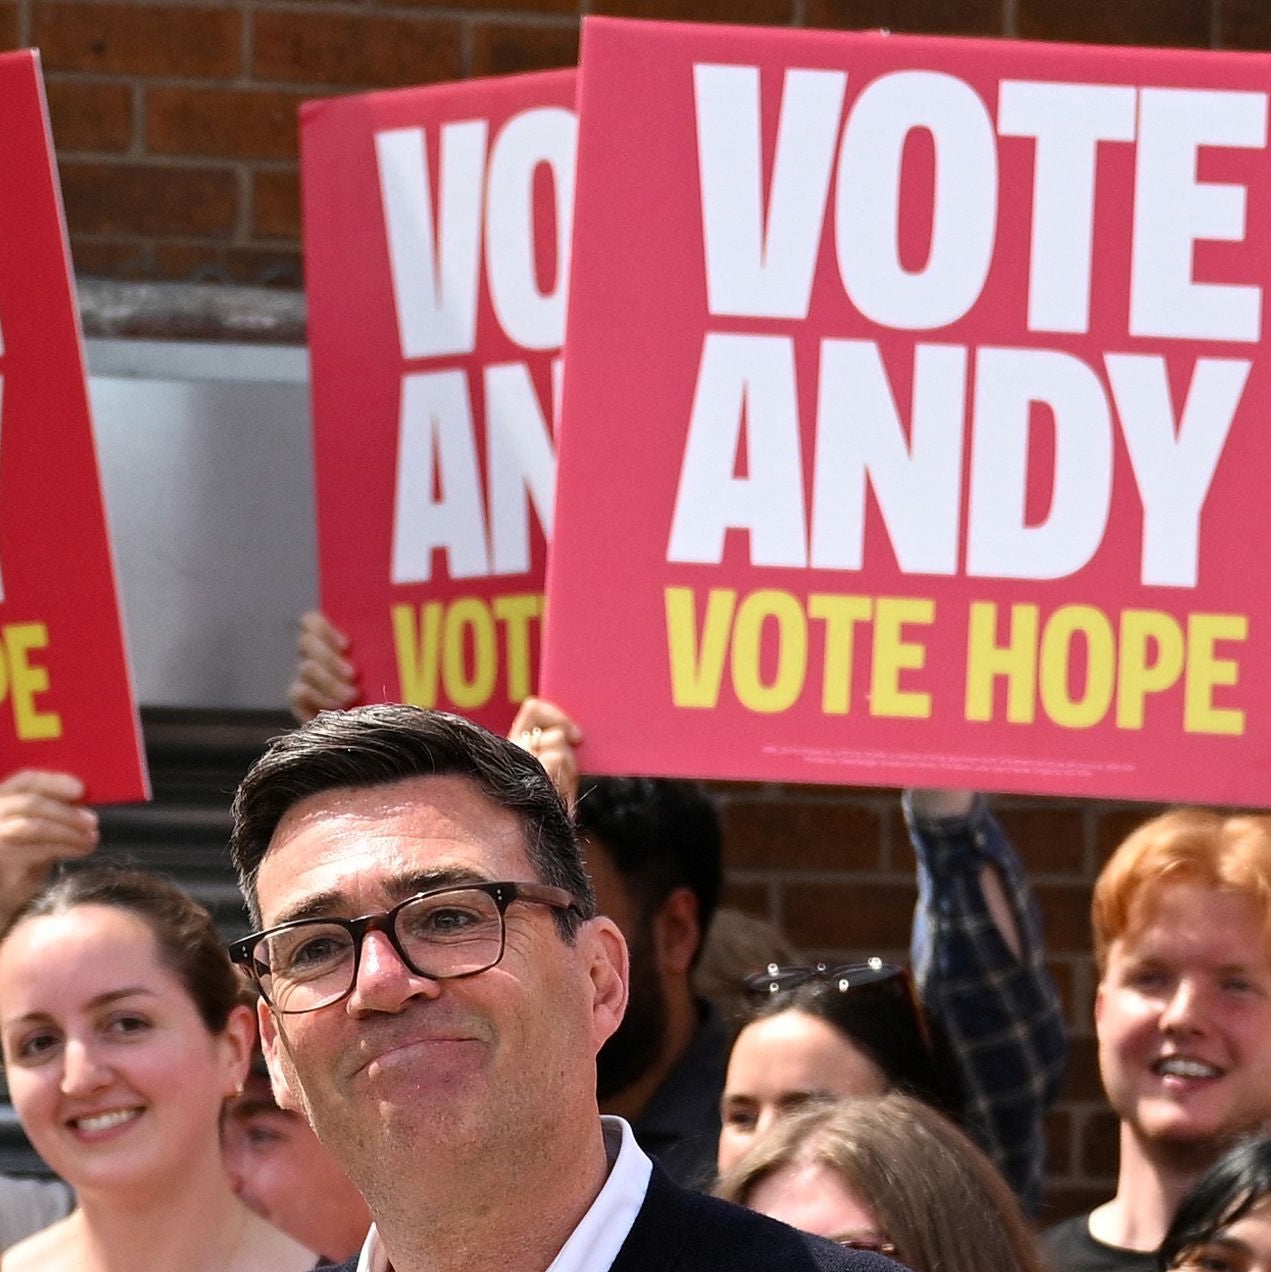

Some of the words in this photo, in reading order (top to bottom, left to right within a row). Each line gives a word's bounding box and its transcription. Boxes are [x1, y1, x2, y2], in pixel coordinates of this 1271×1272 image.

[374, 106, 578, 360] VO
[693, 63, 1269, 343] VOTE
[389, 359, 565, 584] AN
[665, 331, 1254, 588] ANDY
[391, 594, 546, 709] VOT
[664, 586, 935, 719] VOTE
[965, 601, 1250, 737] HOPE
